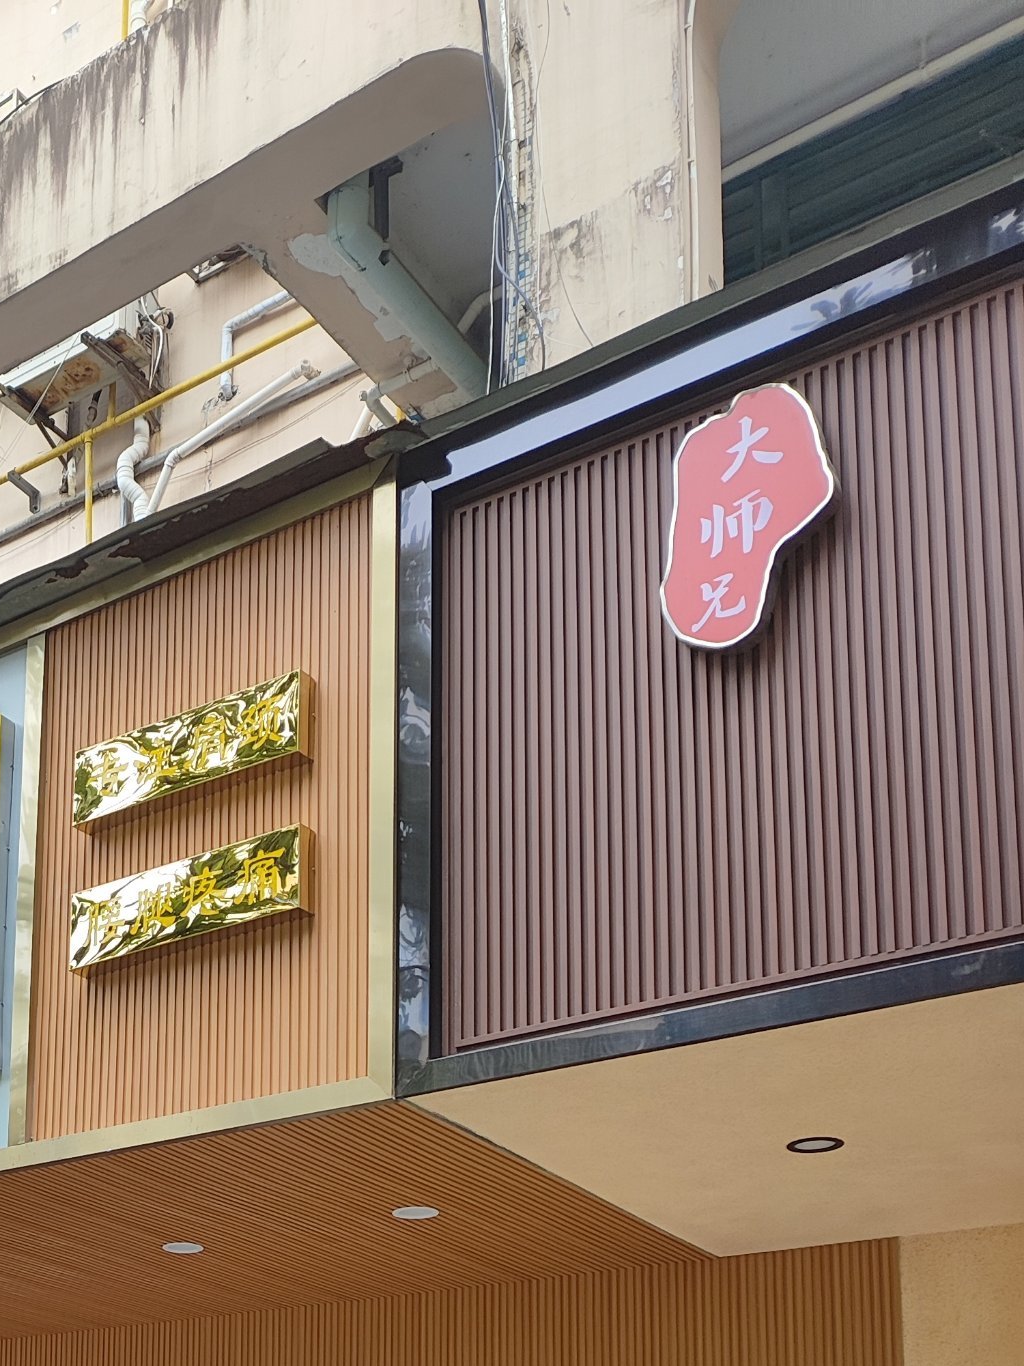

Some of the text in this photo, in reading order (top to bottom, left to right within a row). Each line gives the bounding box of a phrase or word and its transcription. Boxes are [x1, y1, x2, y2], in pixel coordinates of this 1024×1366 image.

[692, 416, 783, 633] 大师兄
[83, 847, 286, 948] 腰腿疼痛
